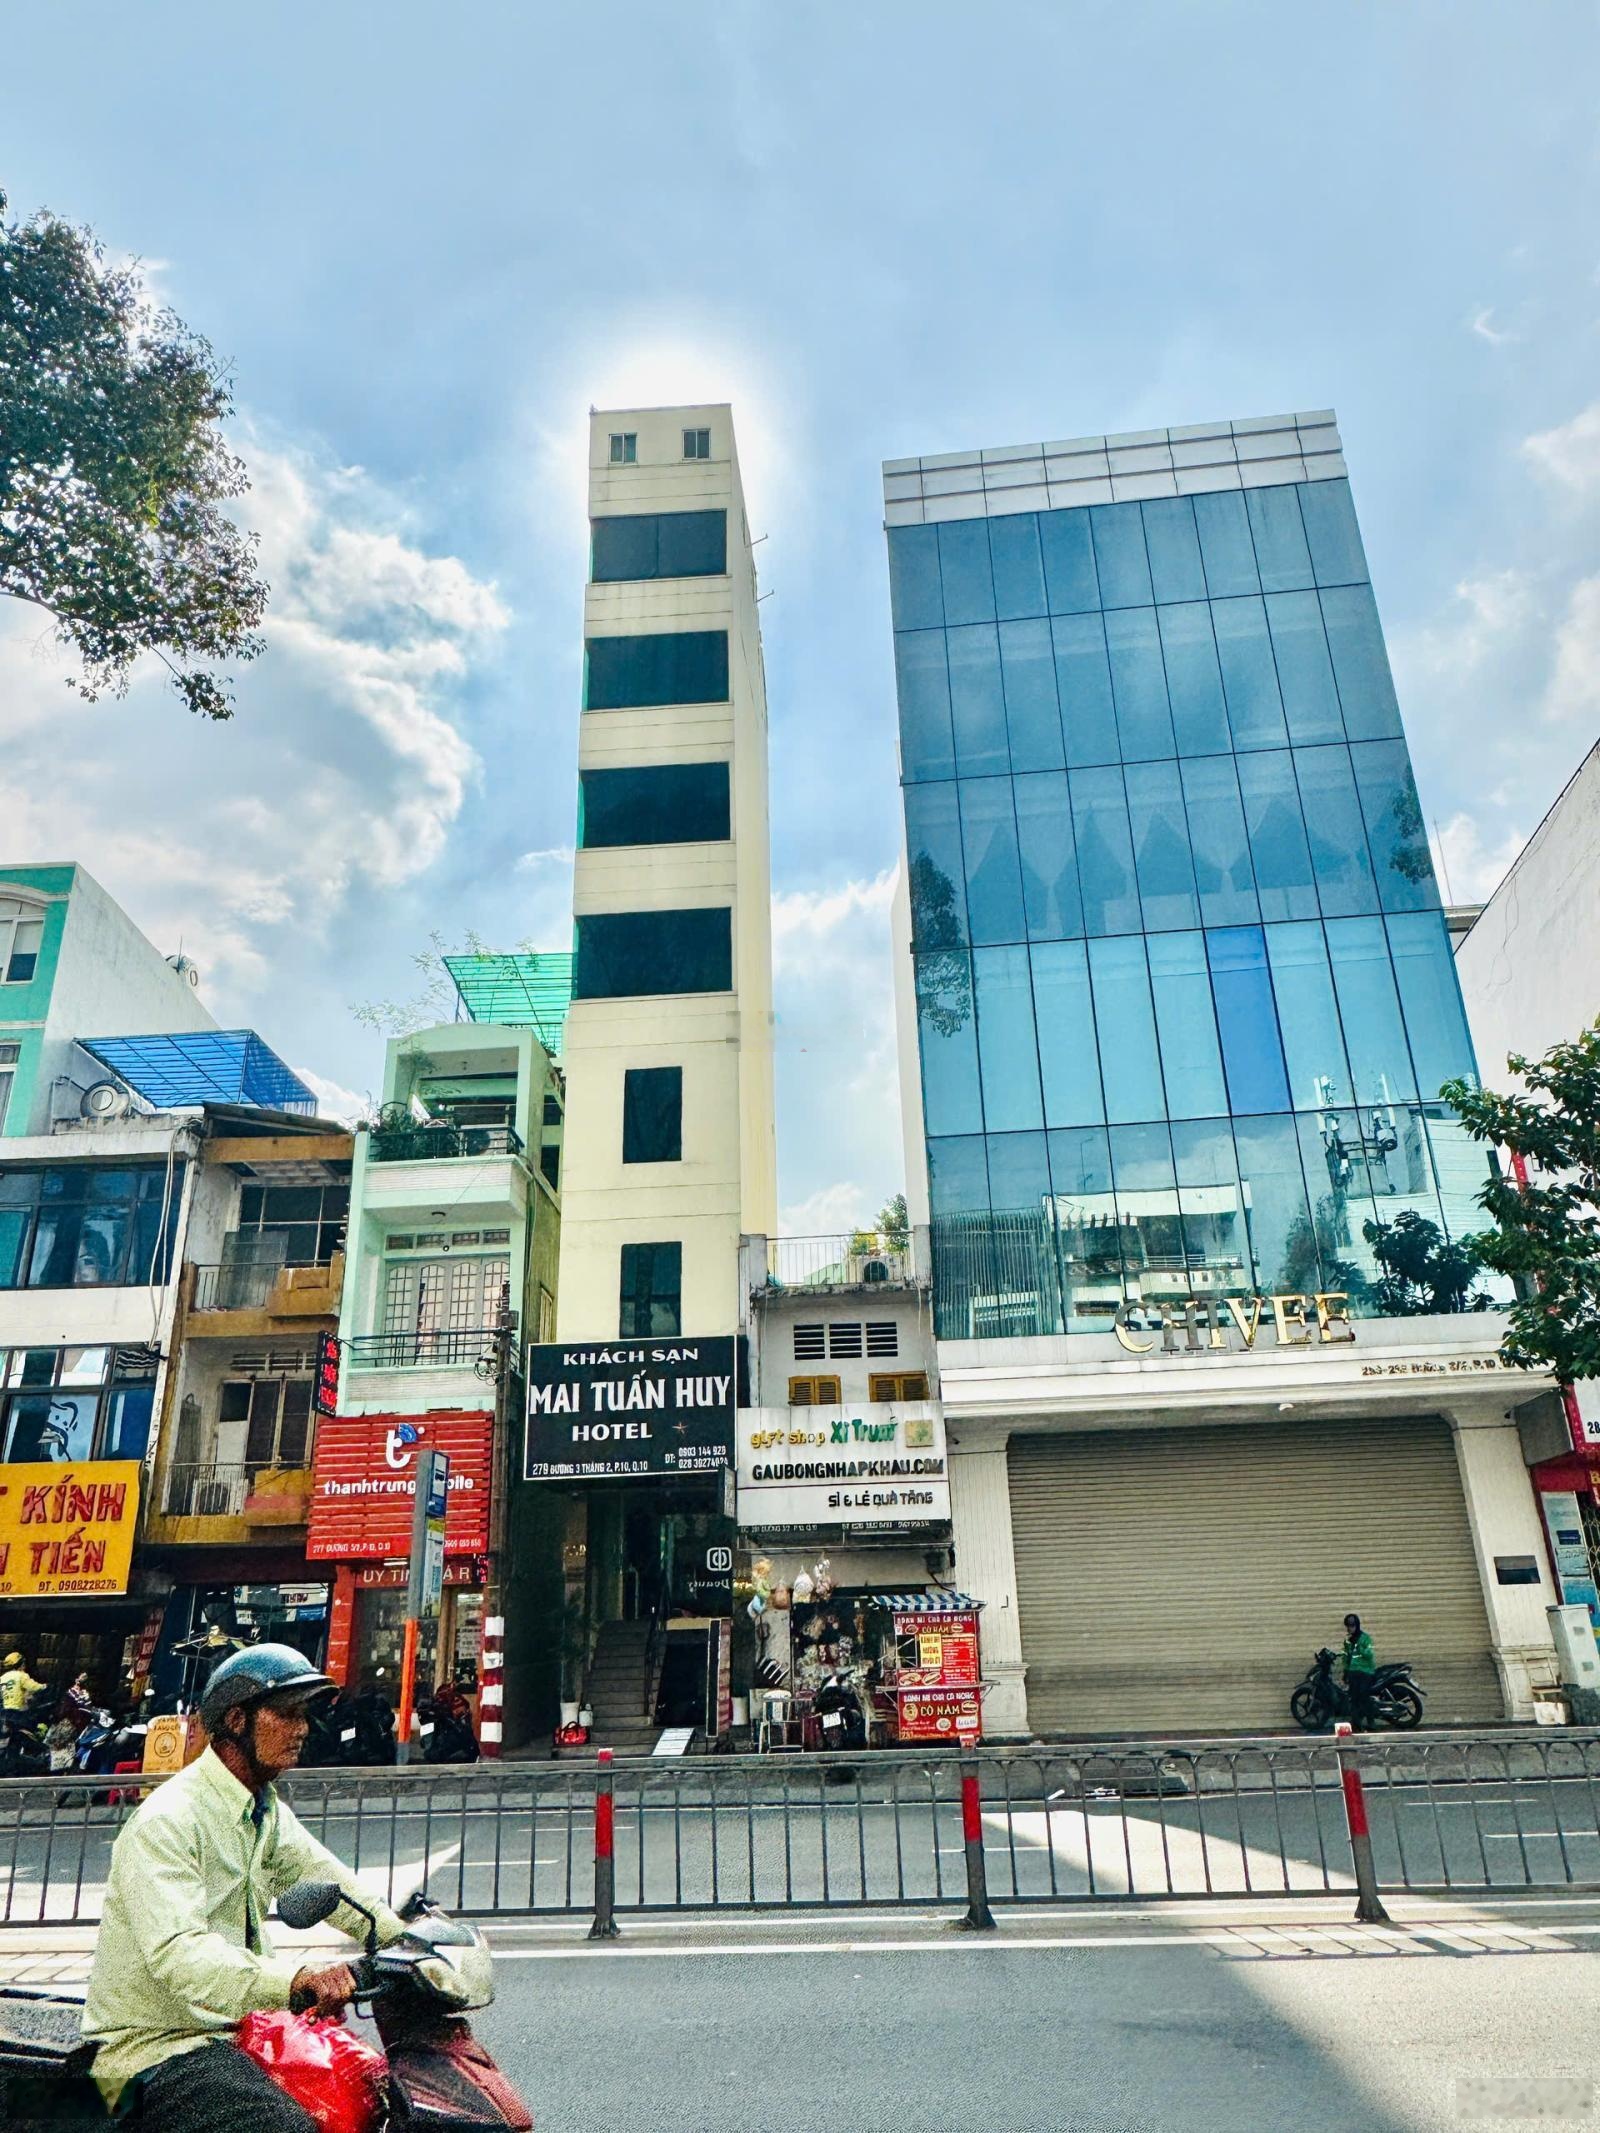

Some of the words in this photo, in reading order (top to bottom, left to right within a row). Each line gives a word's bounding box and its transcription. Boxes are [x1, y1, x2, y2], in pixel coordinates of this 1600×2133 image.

[1114, 1292, 1356, 1353] CHIVEE
[563, 1348, 645, 1366] KHÁCH
[652, 1347, 699, 1364] SẠN
[529, 1382, 580, 1415] MAI
[590, 1369, 665, 1412] TUẤN
[676, 1375, 731, 1408] HUY
[571, 1422, 653, 1442] HOTEL
[750, 1428, 784, 1448] gift
[532, 1462, 548, 1476] 279
[575, 1463, 580, 1474] 3
[752, 1458, 944, 1481] GAUBONGNHAPKHAU.COM
[19, 1473, 127, 1524] KÍNH
[844, 1495, 852, 1507] &
[29, 1526, 107, 1576] TIẾN
[363, 1569, 385, 1583] UY
